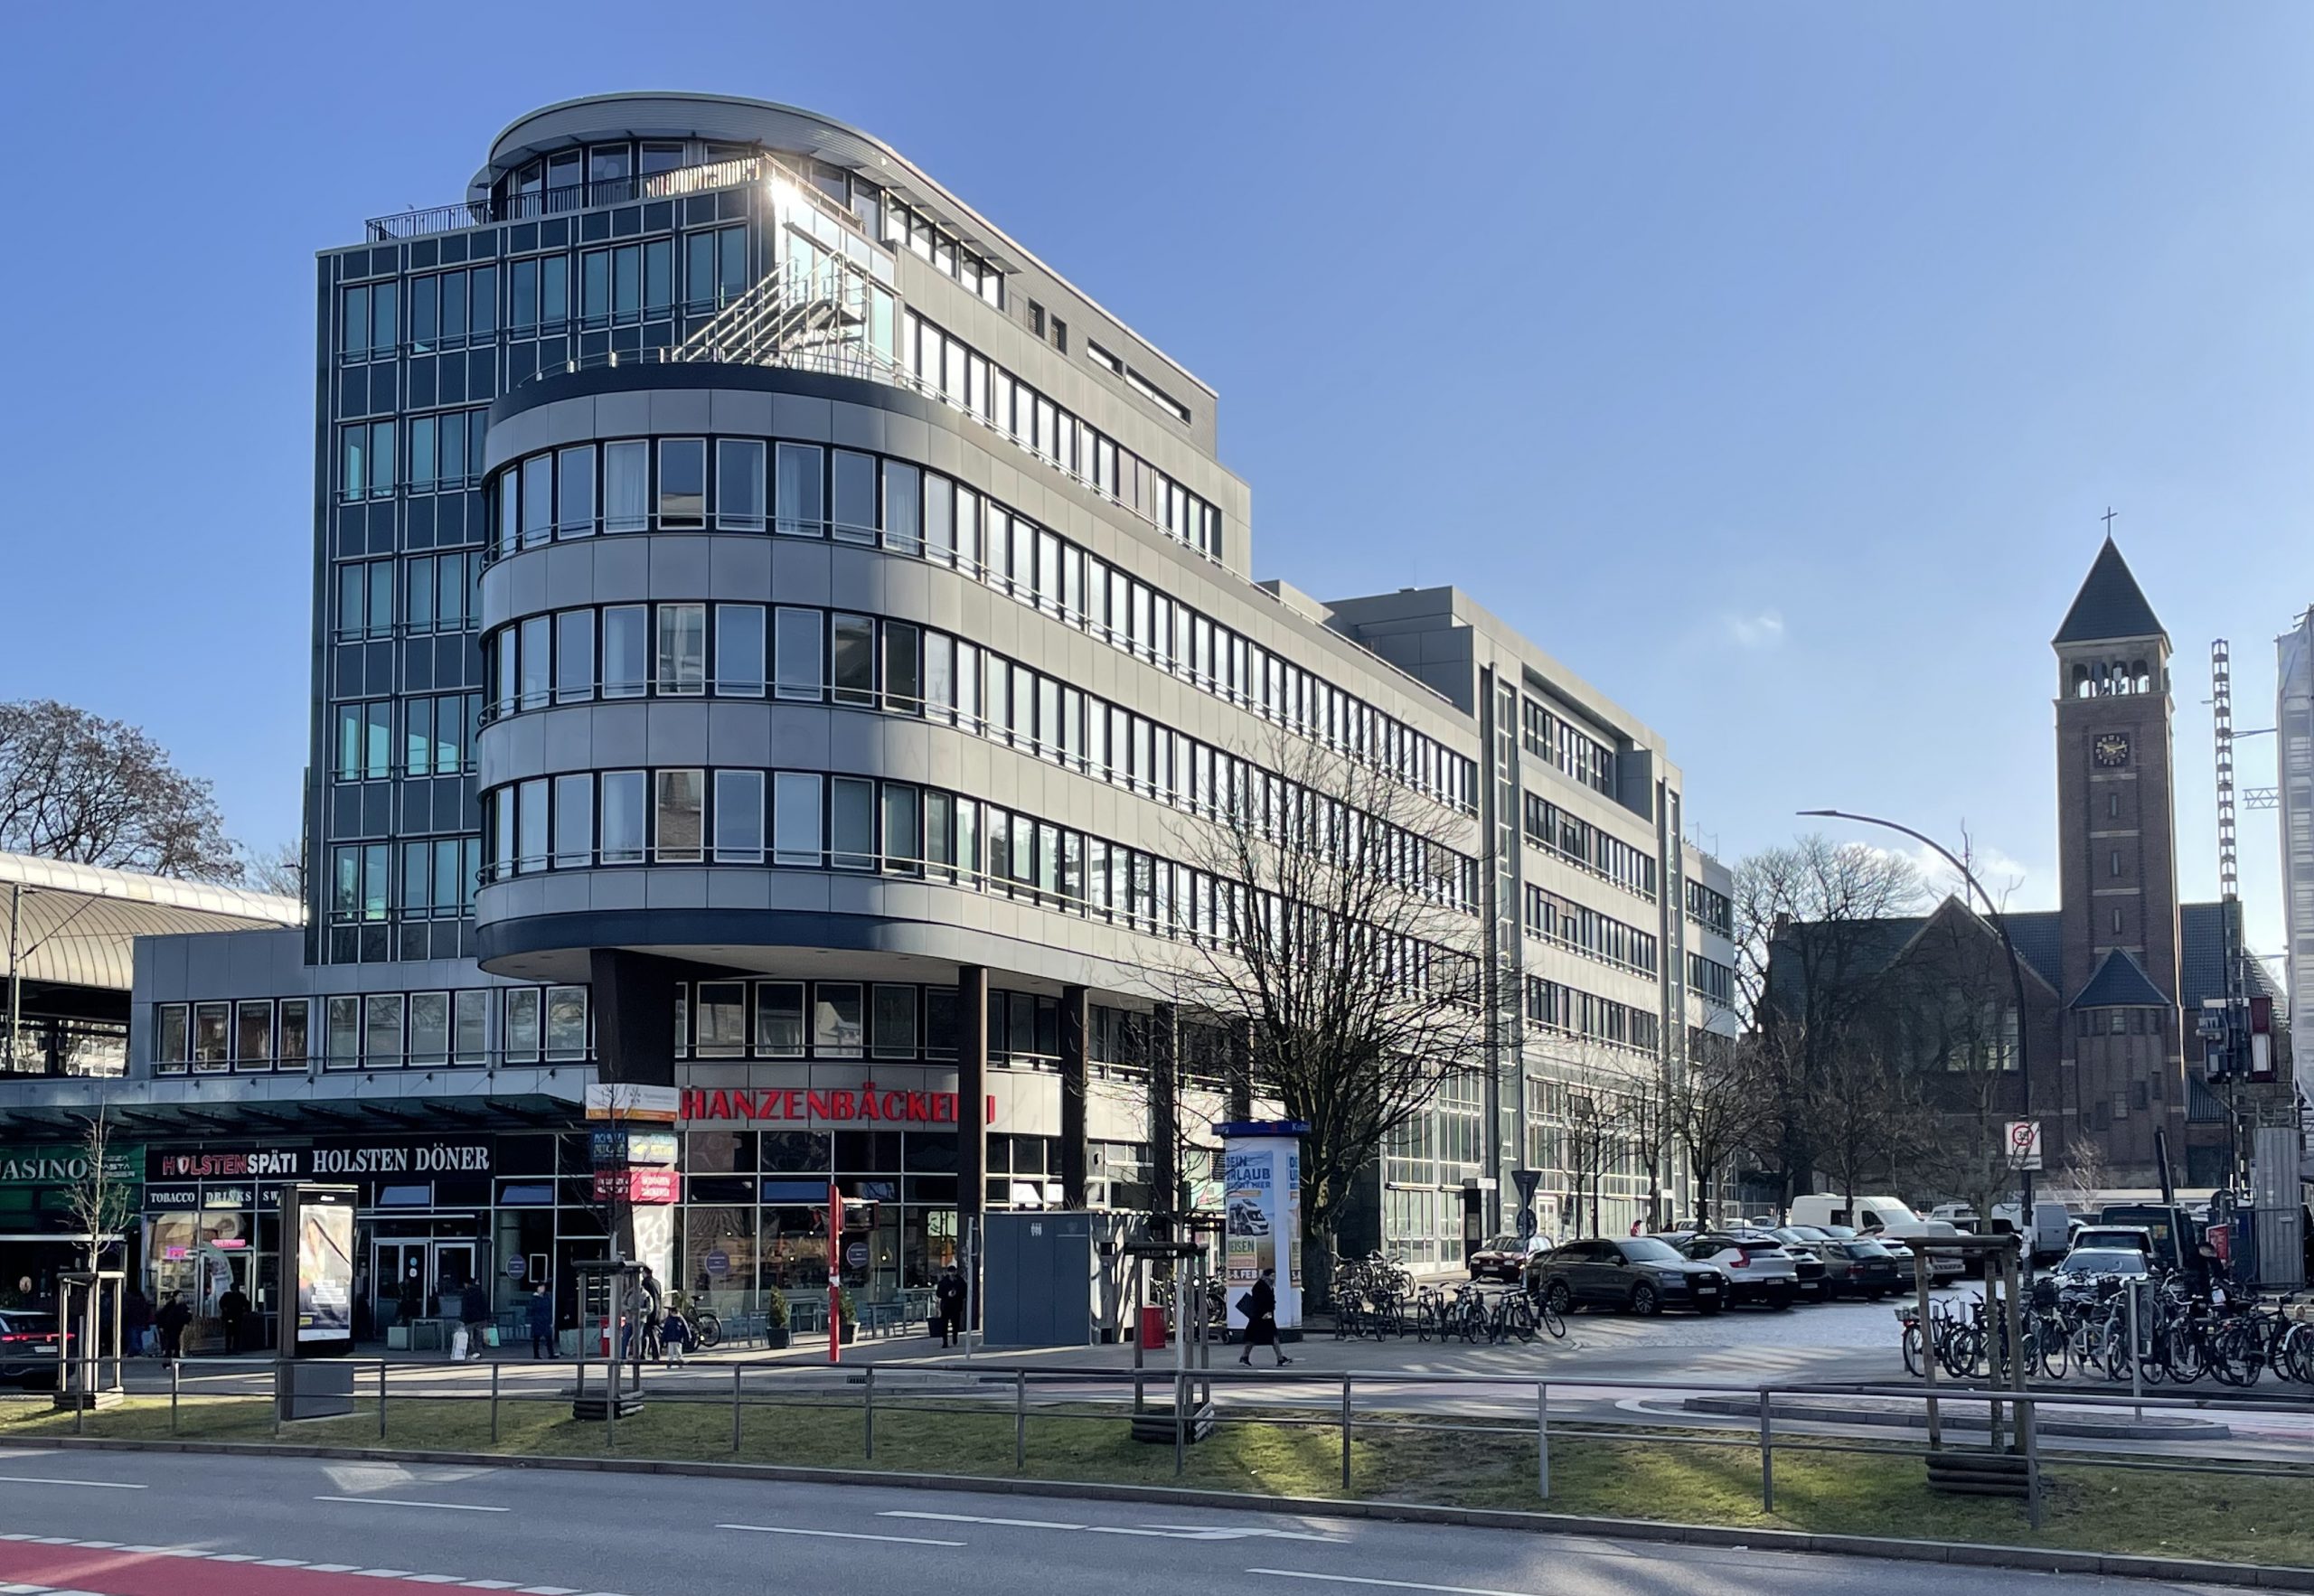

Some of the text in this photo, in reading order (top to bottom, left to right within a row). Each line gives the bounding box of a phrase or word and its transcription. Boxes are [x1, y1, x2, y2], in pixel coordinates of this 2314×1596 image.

[681, 1081, 996, 1125] HANZENBÄCKEI
[312, 1142, 490, 1173] HOLSTEN DÖNER
[0, 1158, 89, 1179] ASINO
[150, 1191, 196, 1204] TOBACCO
[205, 1190, 253, 1203] DRINKS
[262, 1190, 280, 1202] SW
